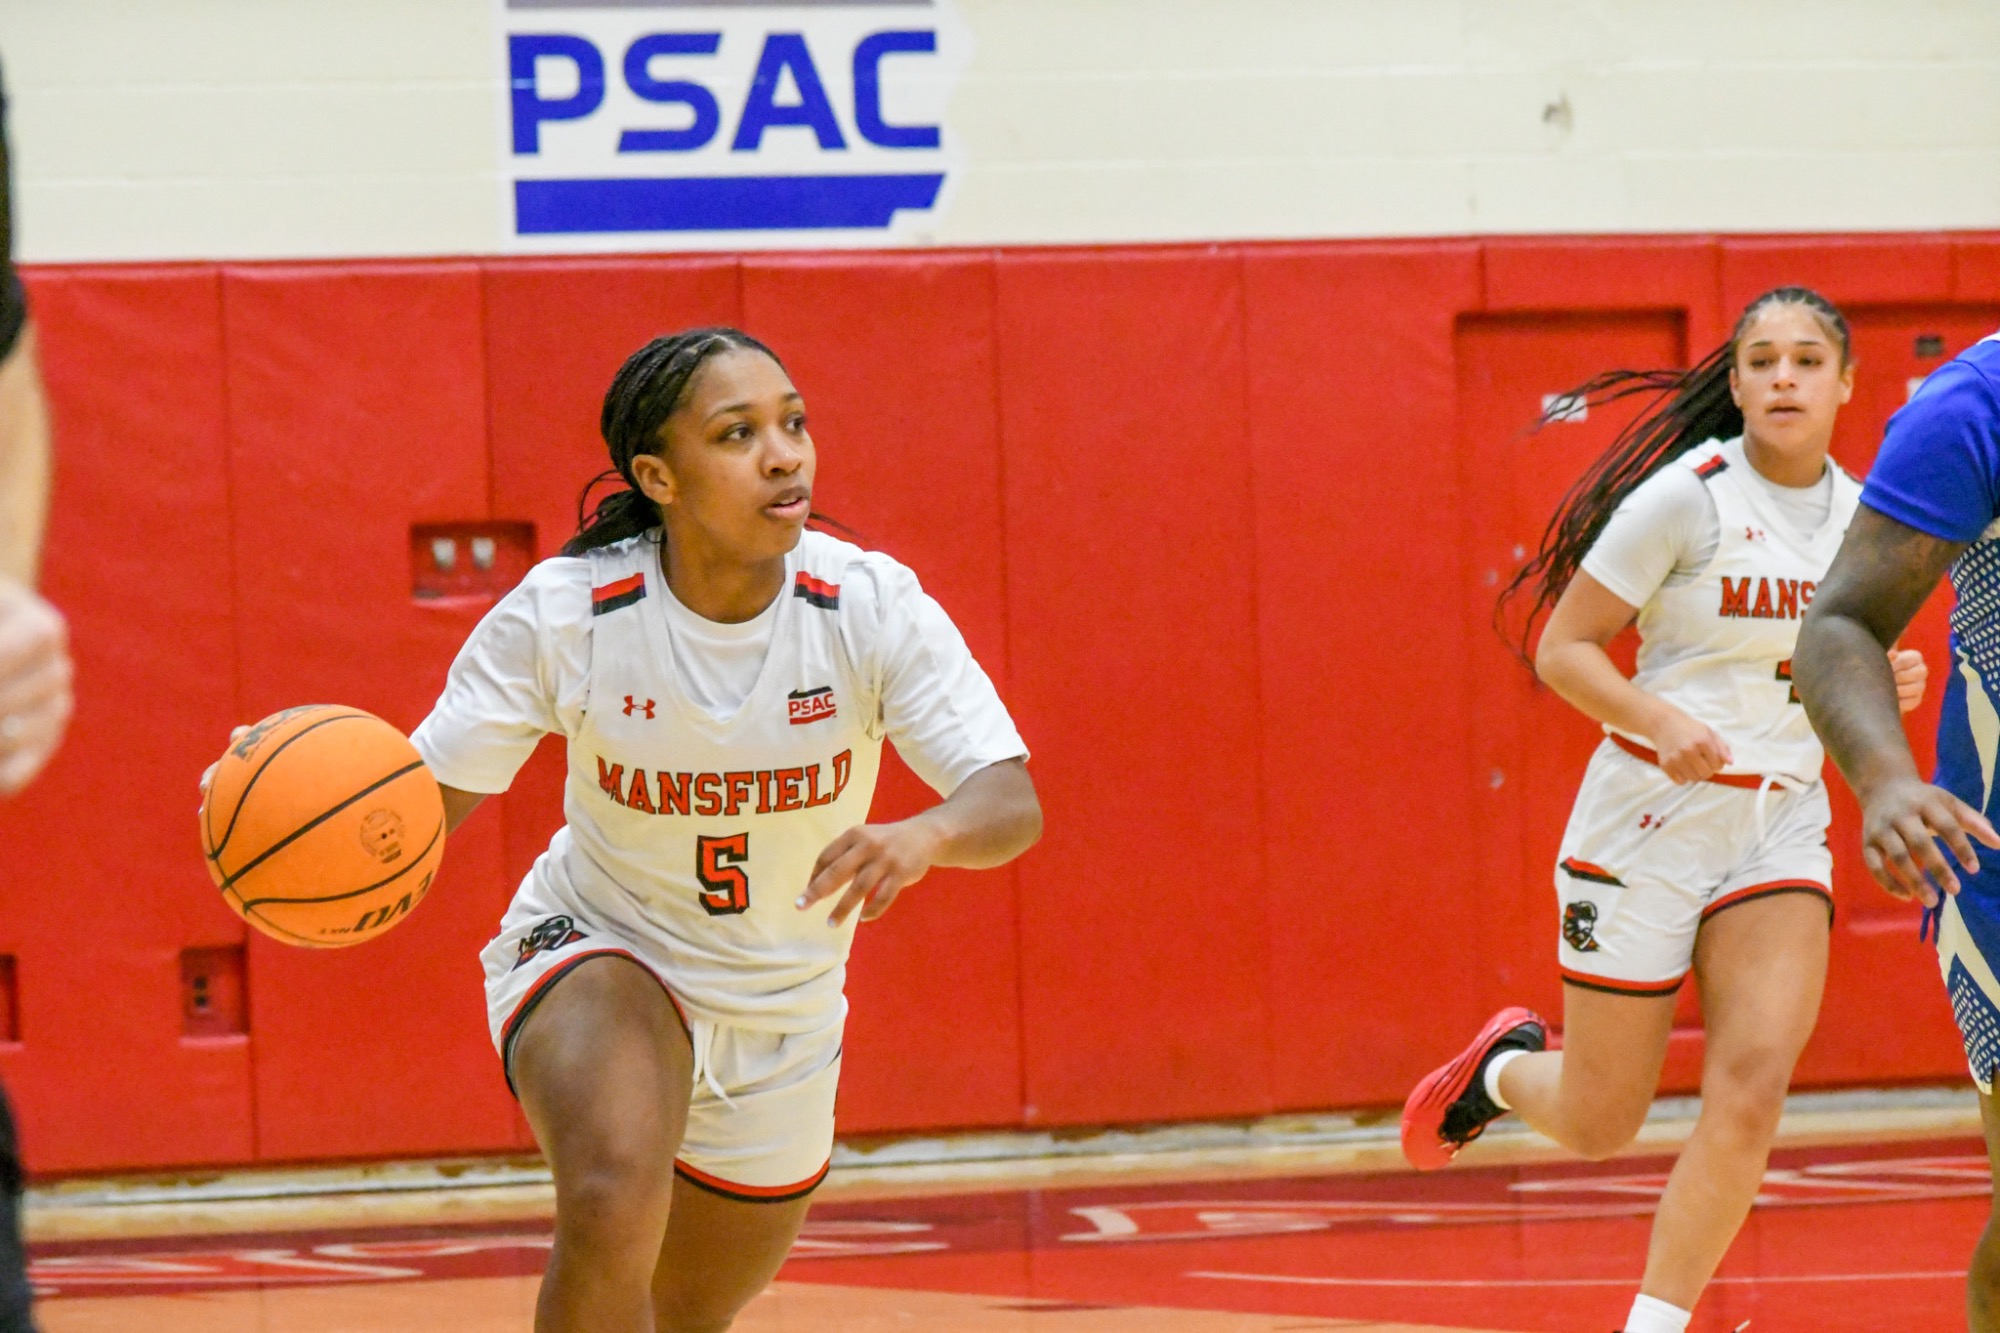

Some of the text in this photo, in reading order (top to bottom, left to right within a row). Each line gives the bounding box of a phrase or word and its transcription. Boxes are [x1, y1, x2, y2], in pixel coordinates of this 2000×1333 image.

[507, 29, 941, 155] PSAC
[1719, 576, 1824, 620] MANS
[788, 692, 835, 717] PSAC
[596, 748, 852, 816] MANSFIELD
[695, 831, 750, 916] 5
